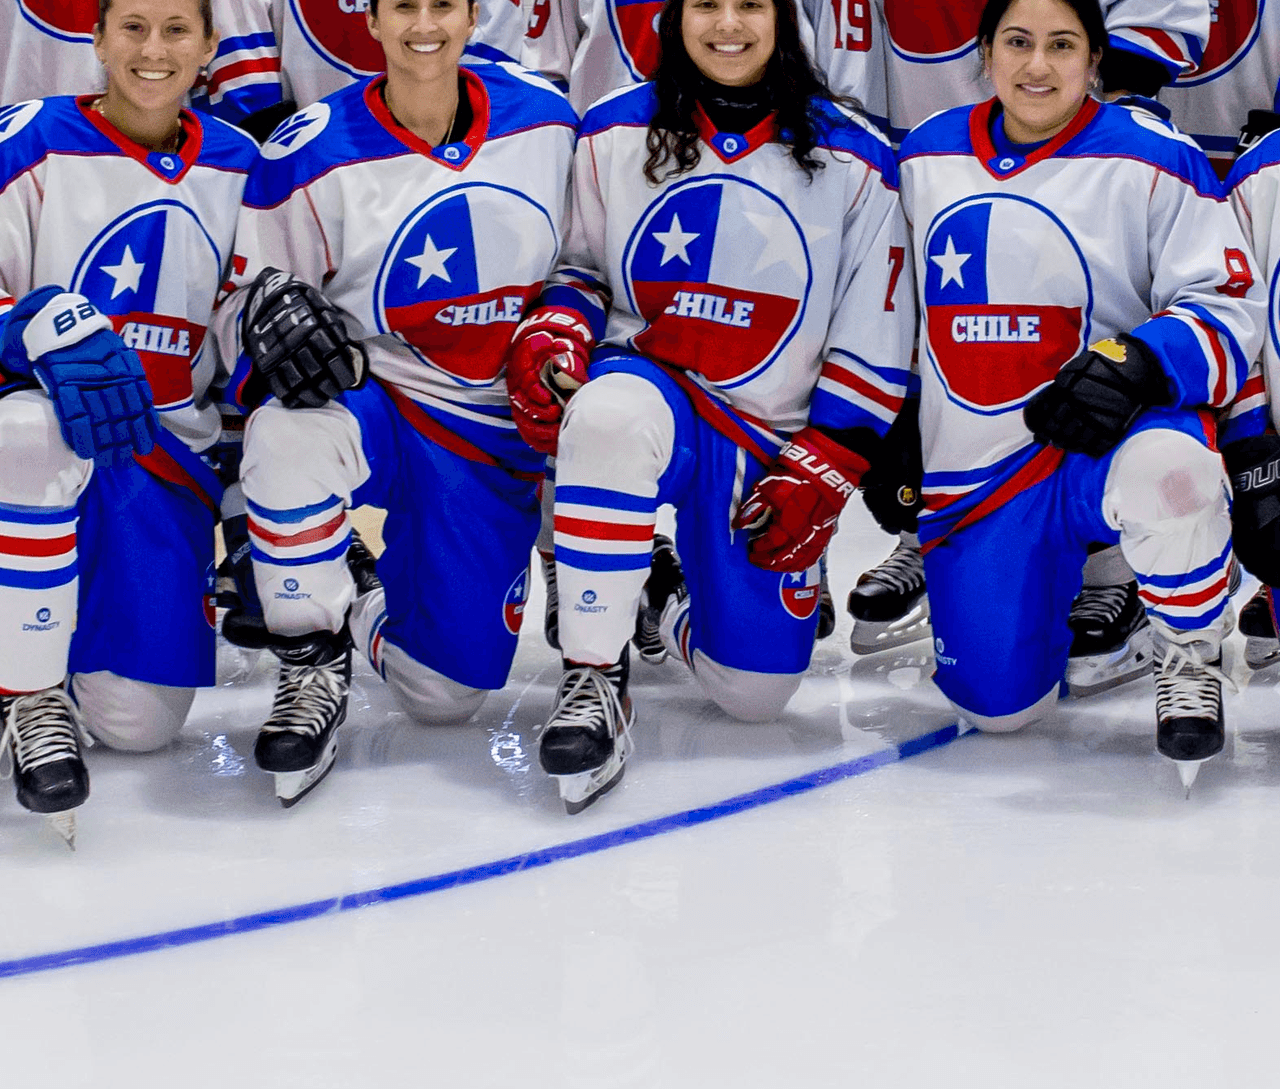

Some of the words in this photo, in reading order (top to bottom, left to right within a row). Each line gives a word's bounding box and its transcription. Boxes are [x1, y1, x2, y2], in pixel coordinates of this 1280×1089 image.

[886, 246, 906, 312] 7
[434, 295, 524, 328] CHILE
[951, 314, 1041, 344] CHILE
